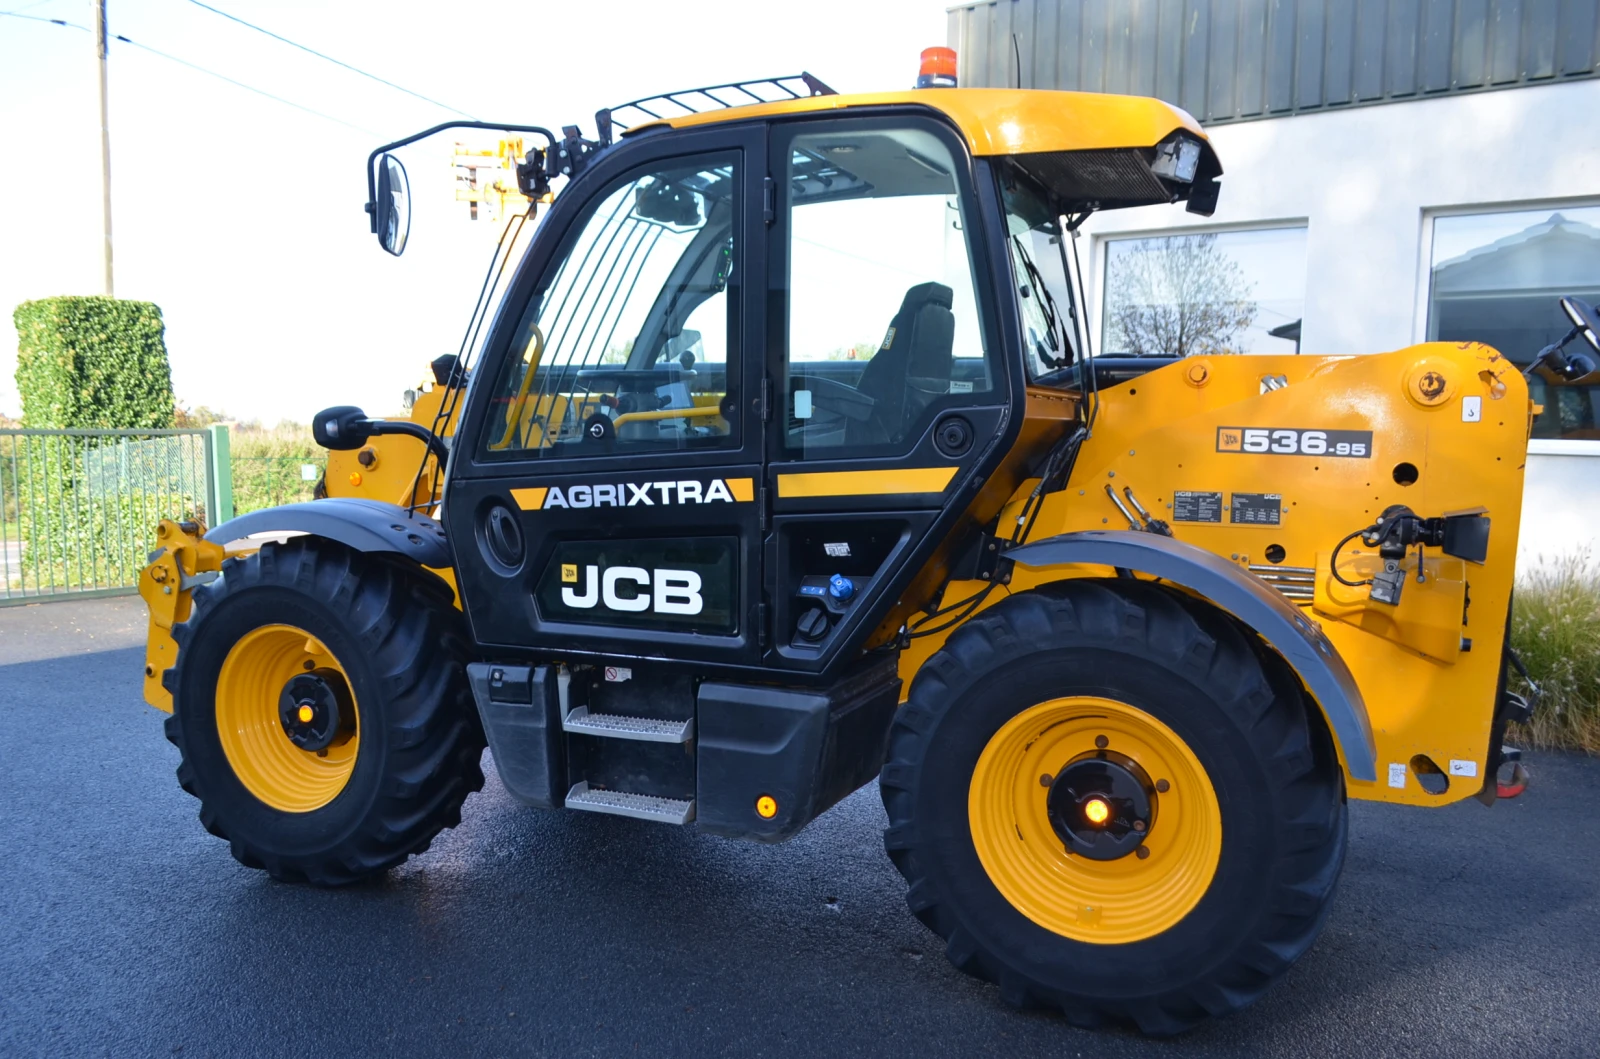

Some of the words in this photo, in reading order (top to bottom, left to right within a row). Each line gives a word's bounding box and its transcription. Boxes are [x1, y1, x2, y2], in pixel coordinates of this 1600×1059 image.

[1243, 429, 1366, 456] 536-95
[543, 479, 733, 509] AGRIXTRA
[561, 565, 703, 615] JCB
